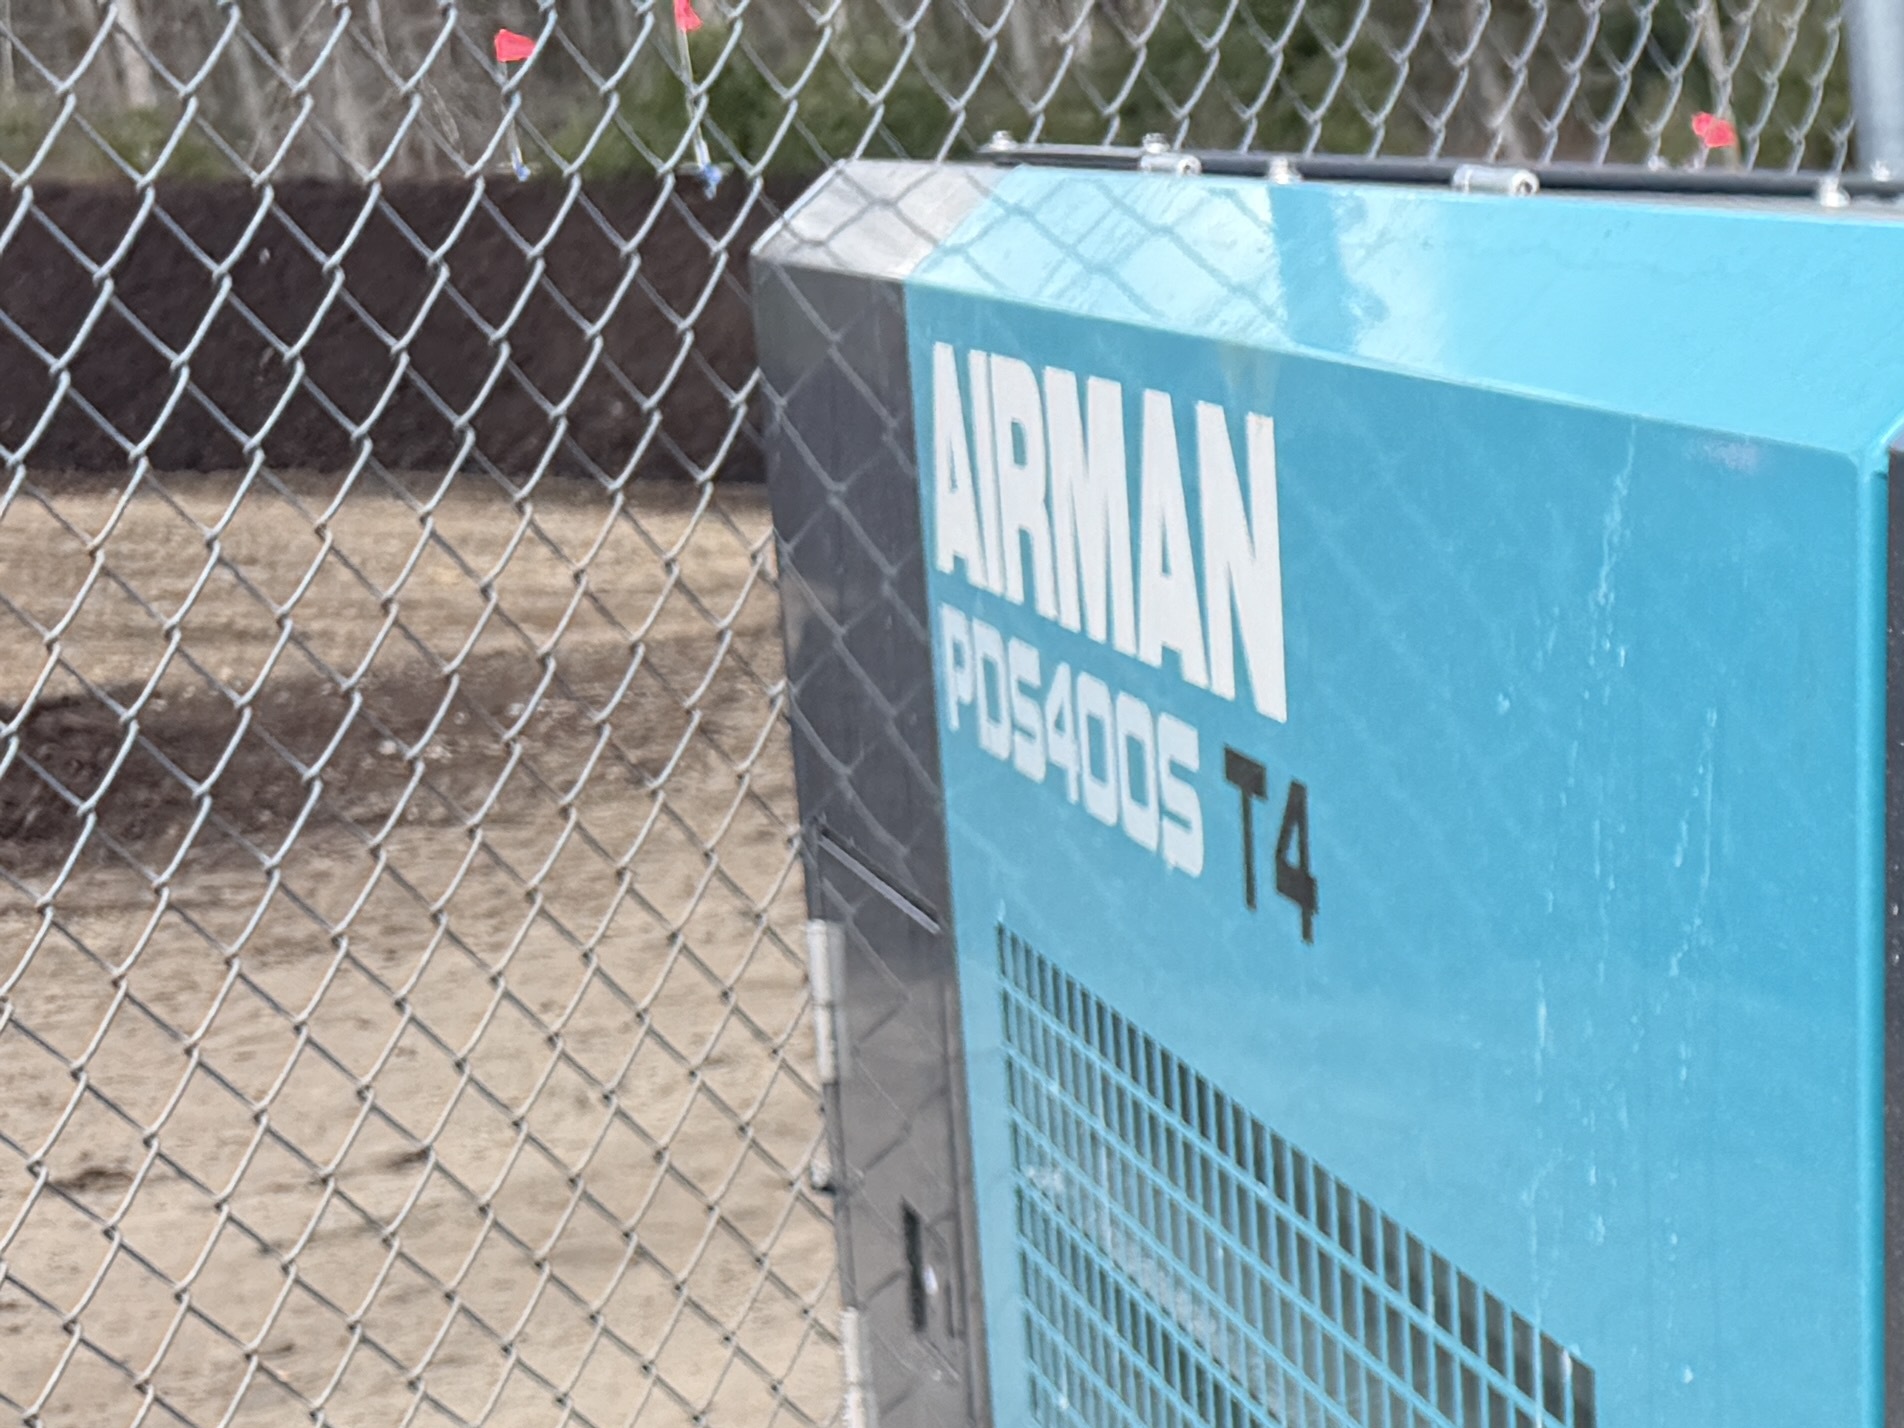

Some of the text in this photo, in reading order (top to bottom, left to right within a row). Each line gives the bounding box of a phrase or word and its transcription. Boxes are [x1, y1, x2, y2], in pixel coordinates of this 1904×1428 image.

[933, 341, 1287, 723] AIRMAN
[939, 602, 1318, 945] PDS400S T4
